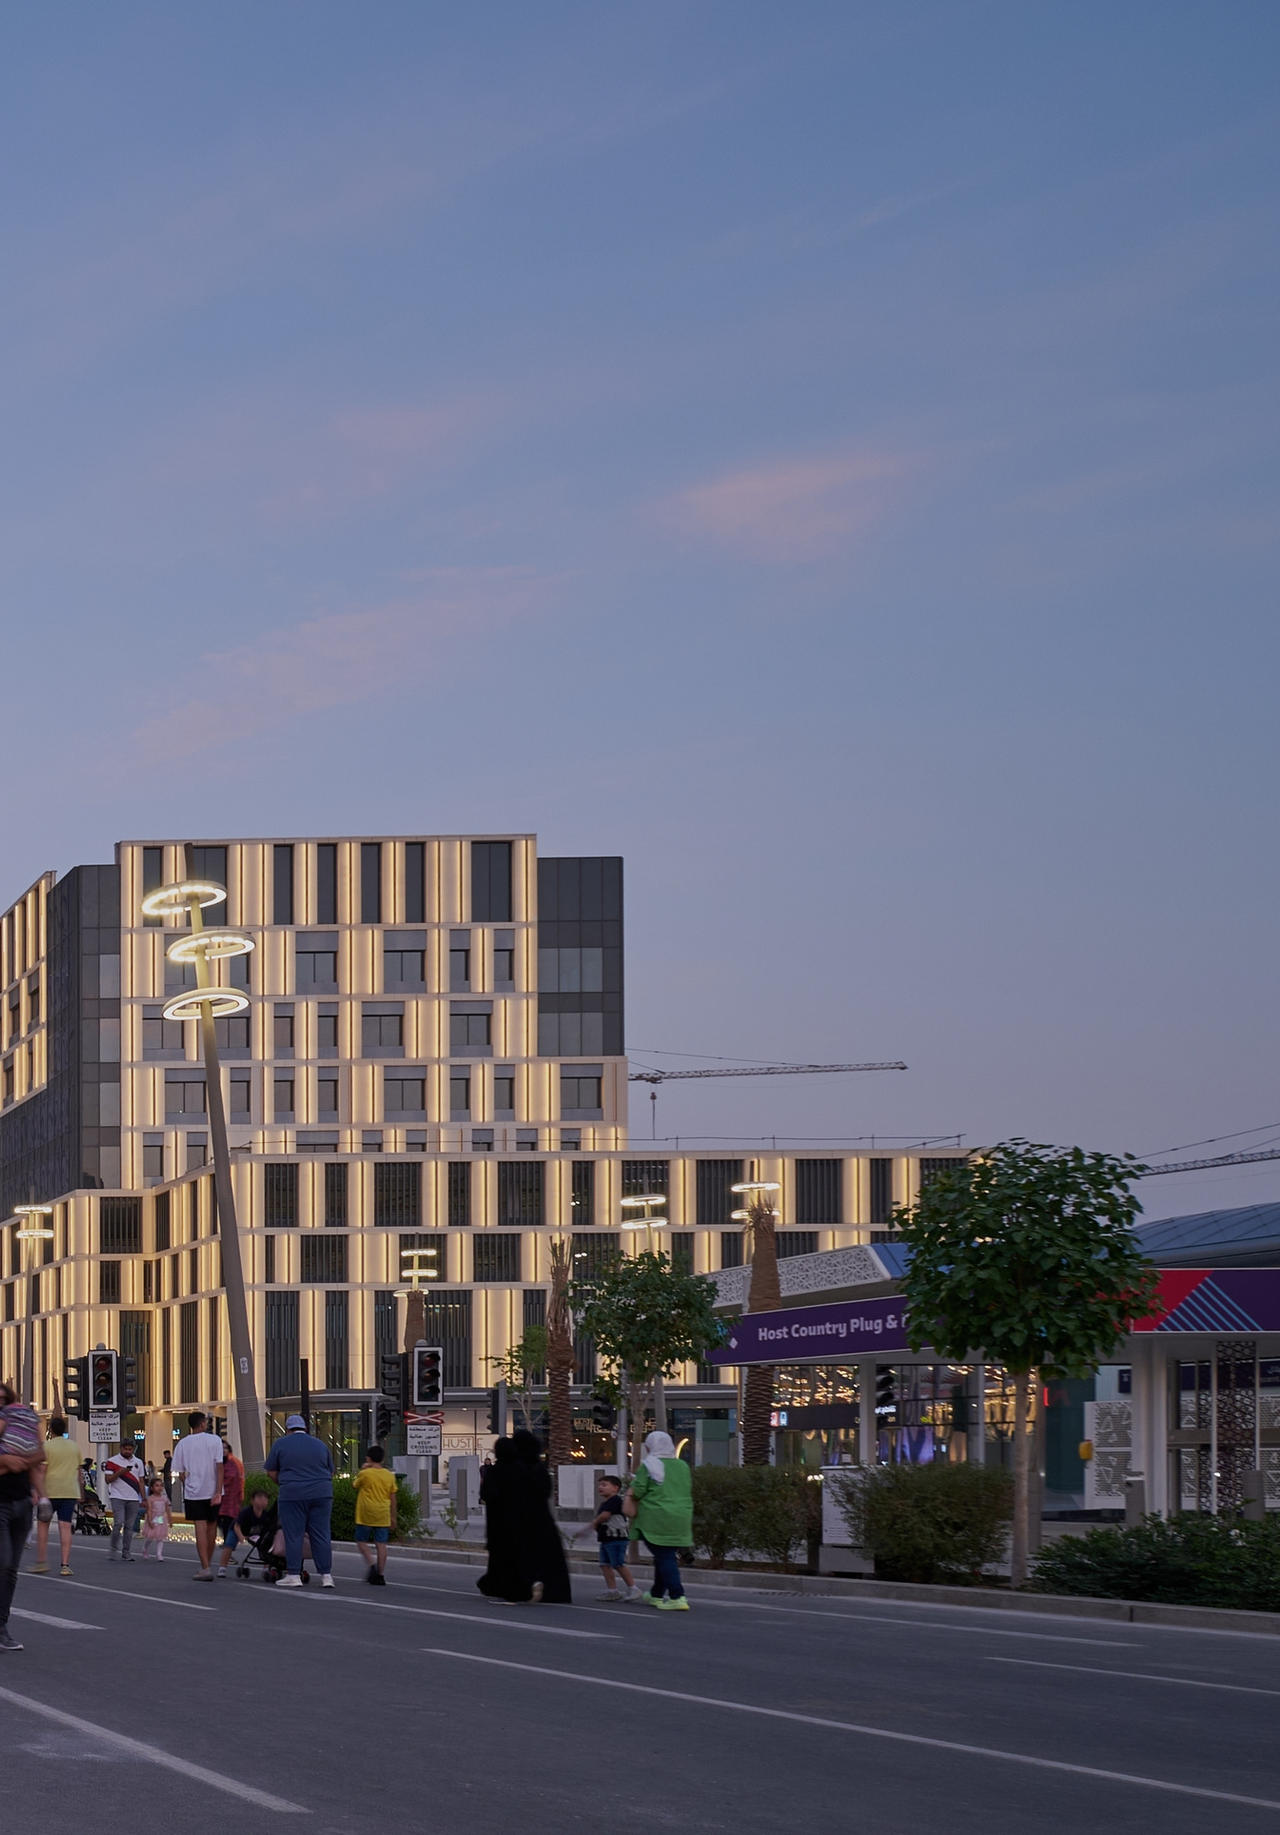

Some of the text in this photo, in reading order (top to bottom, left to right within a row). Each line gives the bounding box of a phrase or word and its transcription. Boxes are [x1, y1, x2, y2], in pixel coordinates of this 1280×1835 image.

[758, 1327, 788, 1340] Host
[791, 1322, 847, 1338] Country
[850, 1316, 882, 1334] Plug
[886, 1314, 898, 1329] &
